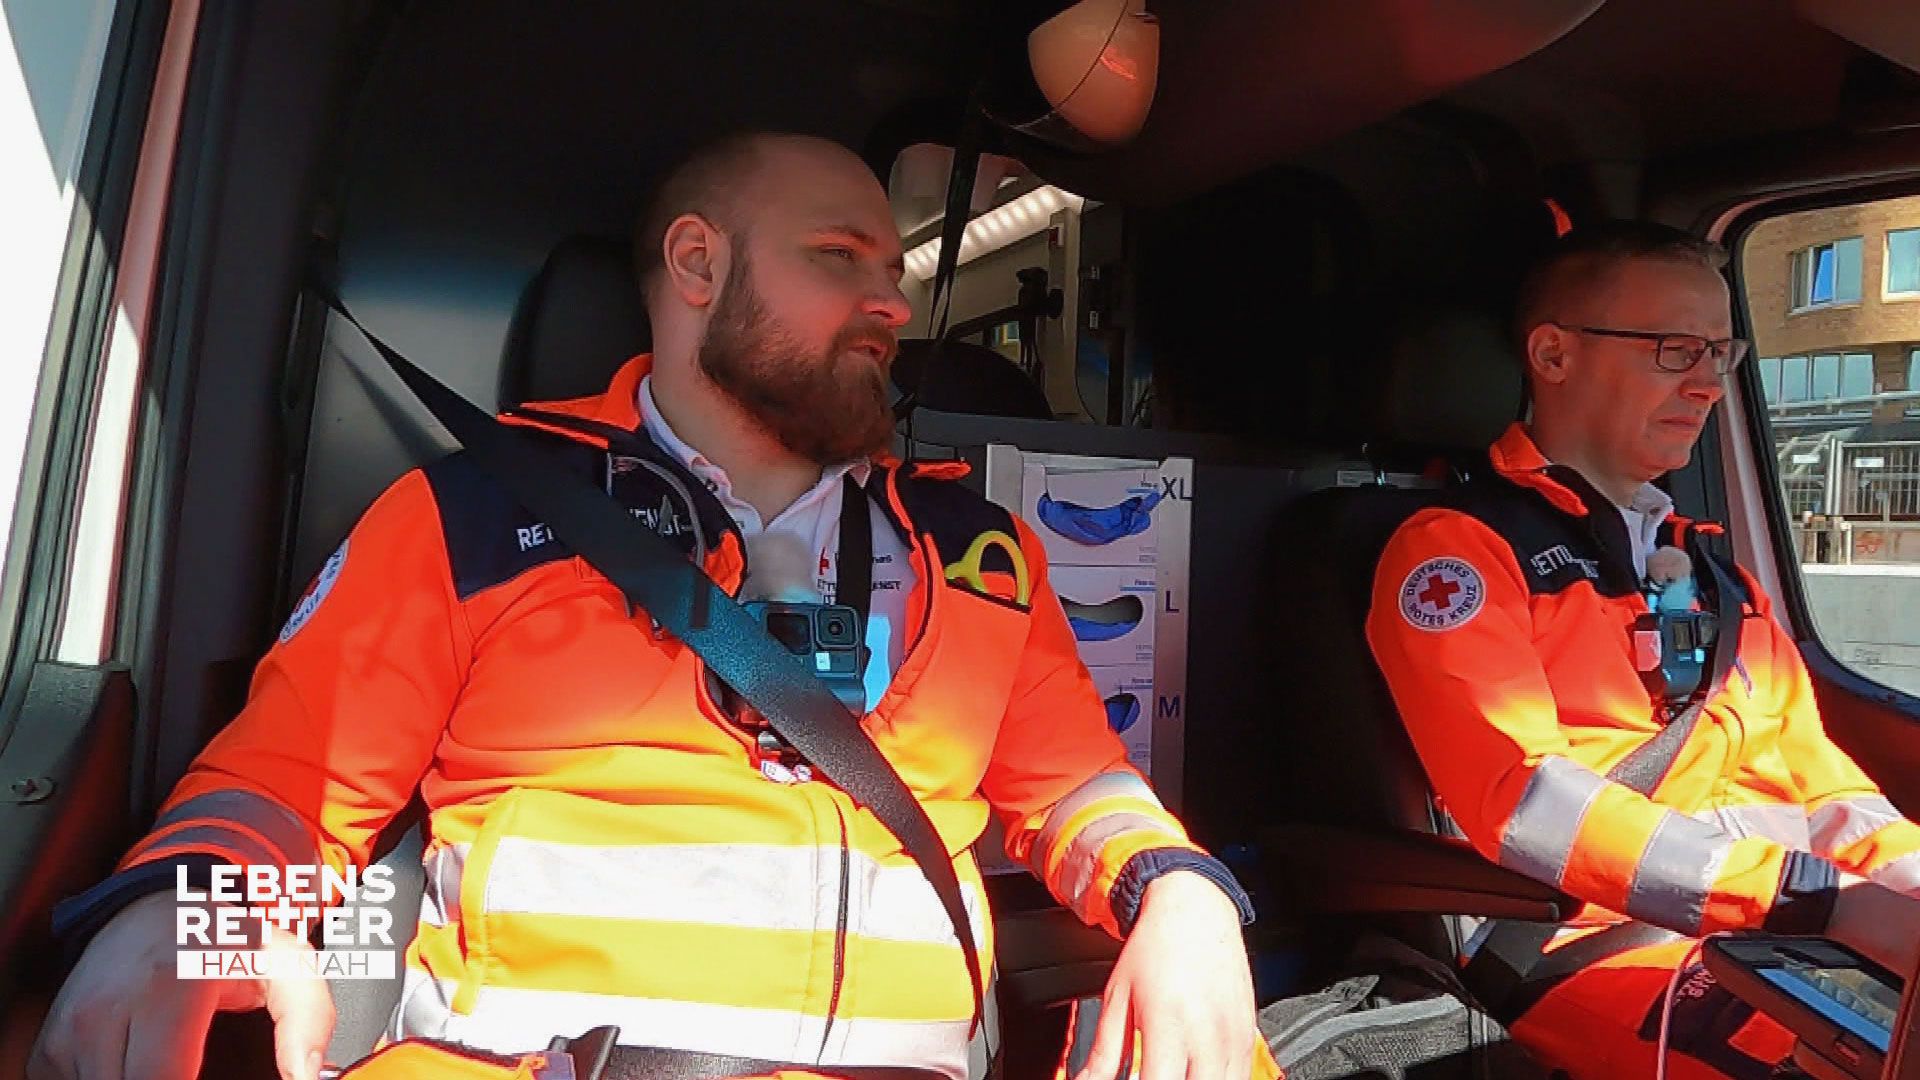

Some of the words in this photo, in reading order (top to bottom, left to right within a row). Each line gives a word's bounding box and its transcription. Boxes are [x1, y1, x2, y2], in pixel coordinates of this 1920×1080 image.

[1161, 477, 1193, 500] XL
[1404, 563, 1470, 597] DEUTSCHES
[1166, 591, 1179, 613] L
[1408, 602, 1445, 626] ROTES
[1449, 584, 1477, 621] KREUZ
[1160, 695, 1180, 718] M
